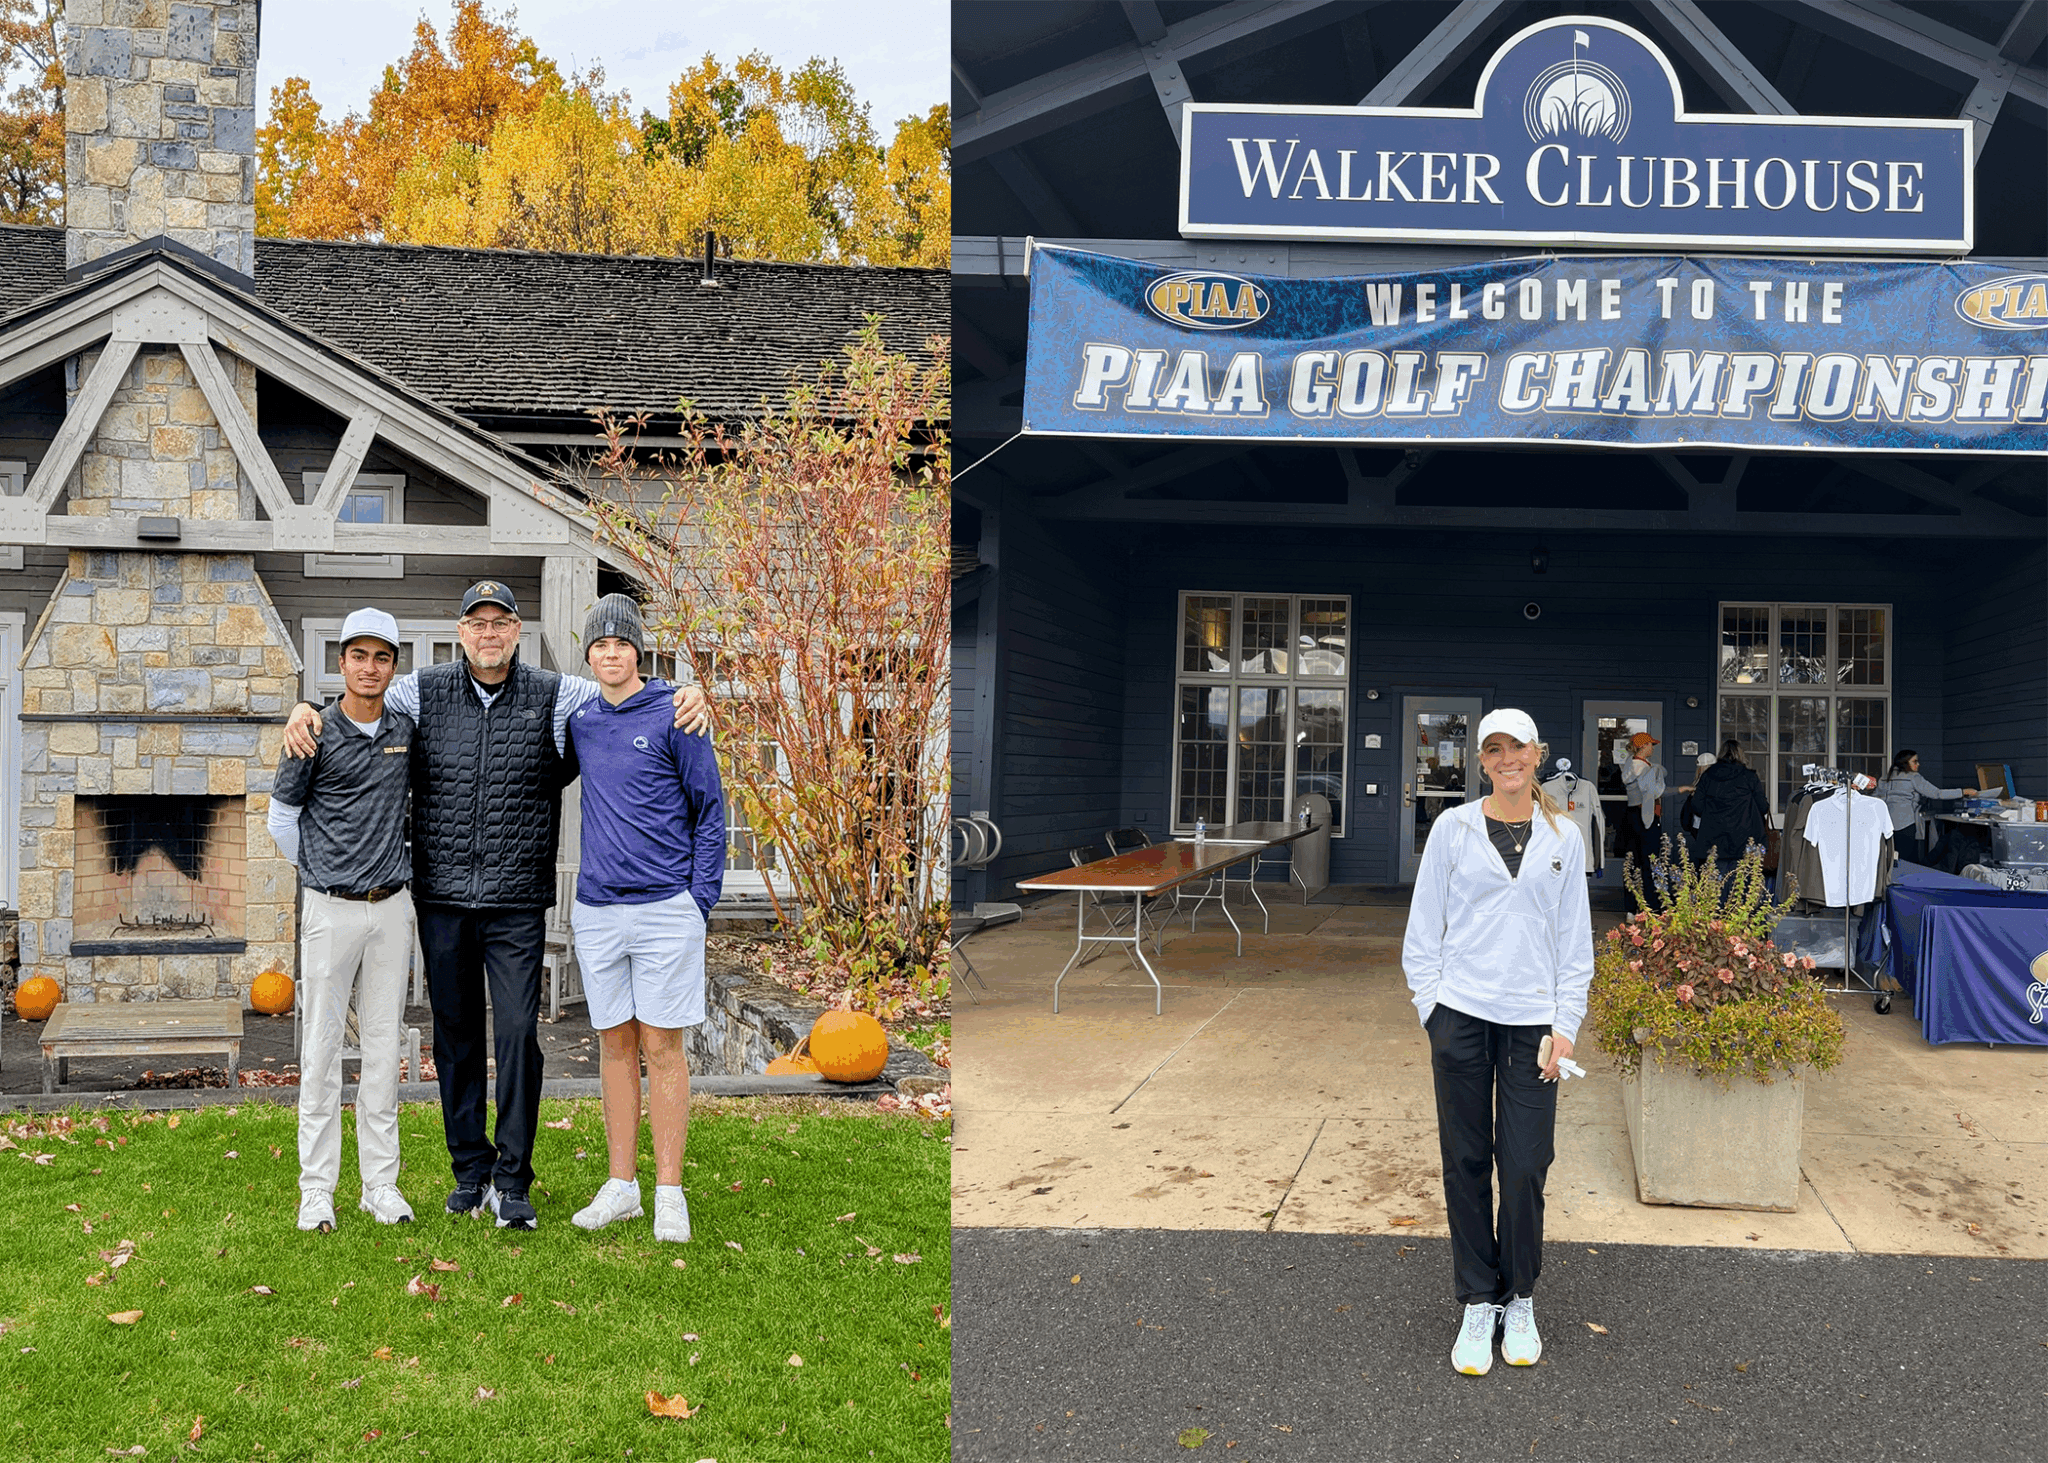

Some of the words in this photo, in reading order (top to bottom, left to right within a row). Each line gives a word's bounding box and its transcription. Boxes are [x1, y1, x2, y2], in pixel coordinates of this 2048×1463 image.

[1227, 138, 1504, 204] WALKER
[1526, 144, 1924, 213] CLUBHOUSE
[1165, 281, 1260, 319] PIAA
[1366, 278, 1622, 326] WELCOME
[1656, 278, 1714, 320] TO
[1749, 281, 1844, 324] THE
[1074, 343, 1269, 418] PIAA
[1288, 349, 1489, 418] GOLF
